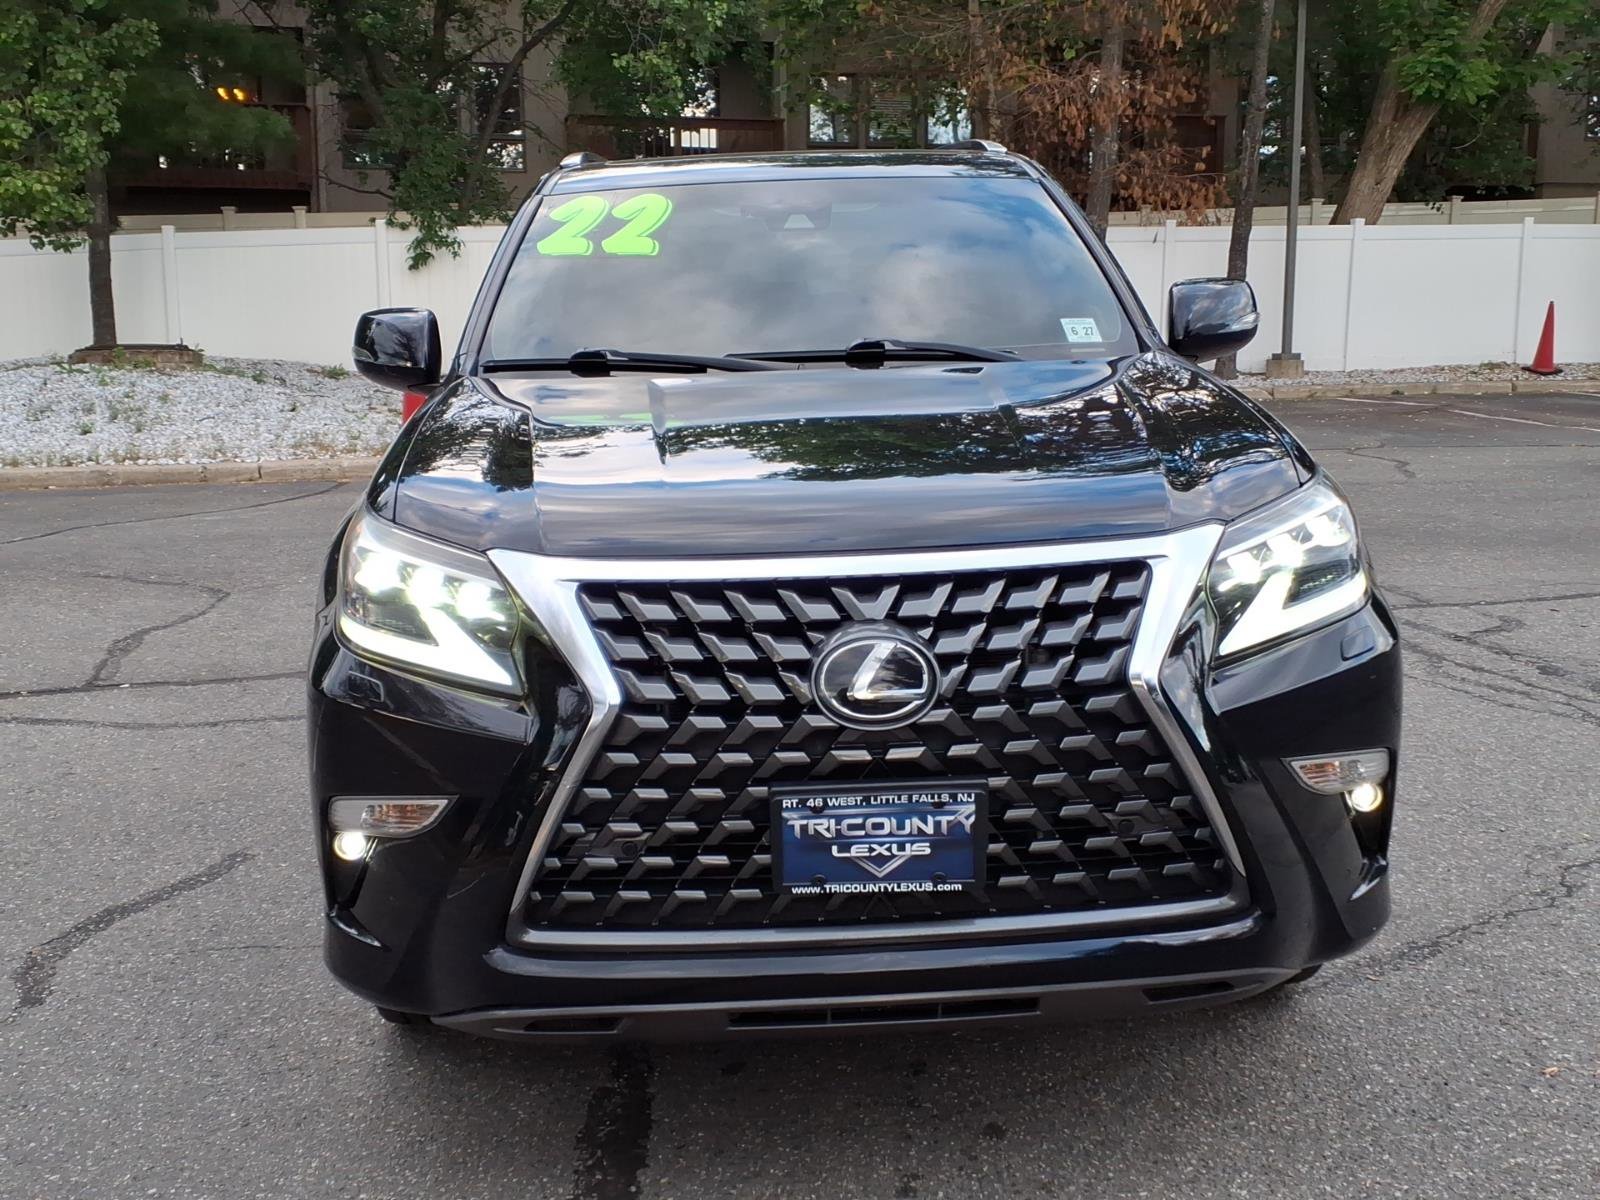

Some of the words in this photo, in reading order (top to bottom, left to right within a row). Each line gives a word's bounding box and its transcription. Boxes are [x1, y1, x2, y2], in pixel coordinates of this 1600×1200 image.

[536, 193, 672, 256] 22
[1070, 326, 1079, 336] 6
[1082, 326, 1094, 336] 27
[782, 799, 802, 809] RT.
[806, 798, 823, 808] 46
[870, 794, 909, 805] LITTLE
[957, 792, 975, 803] NJ
[831, 842, 931, 858] LEXUS
[791, 882, 963, 895] www.TRICOUNTYLEXUS.com
